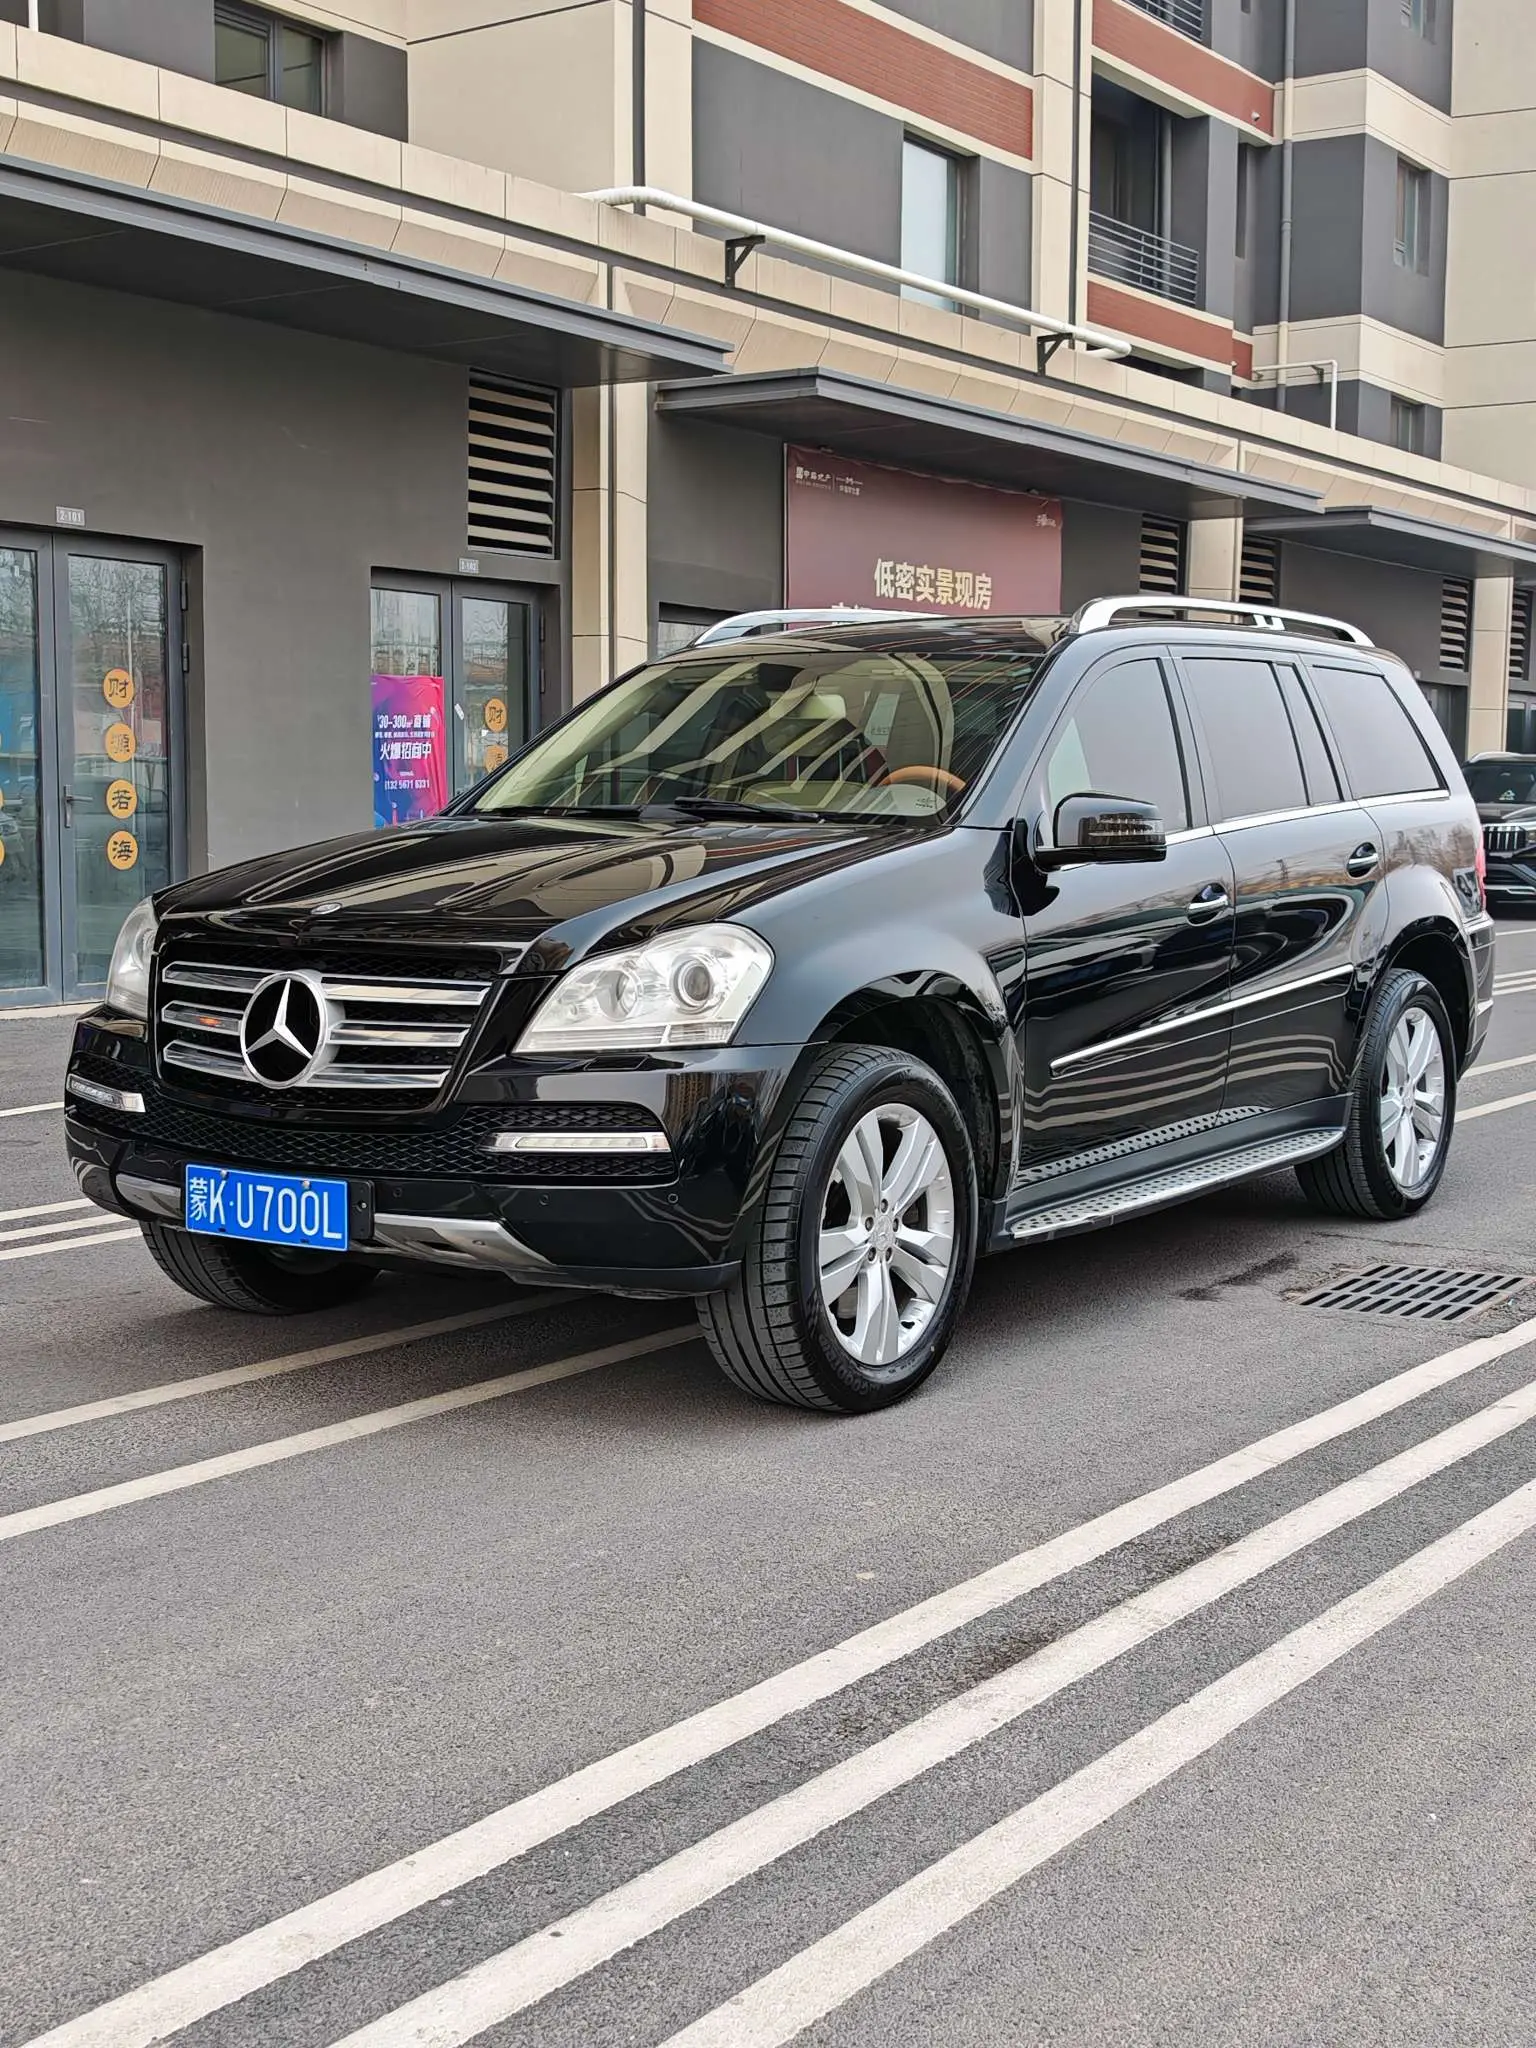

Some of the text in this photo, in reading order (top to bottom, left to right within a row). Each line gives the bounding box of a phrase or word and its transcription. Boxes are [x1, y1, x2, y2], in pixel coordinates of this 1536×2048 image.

[60, 509, 81, 522] 2-101
[874, 558, 992, 610] 低密实景现房
[380, 742, 432, 761] 火爆招商中
